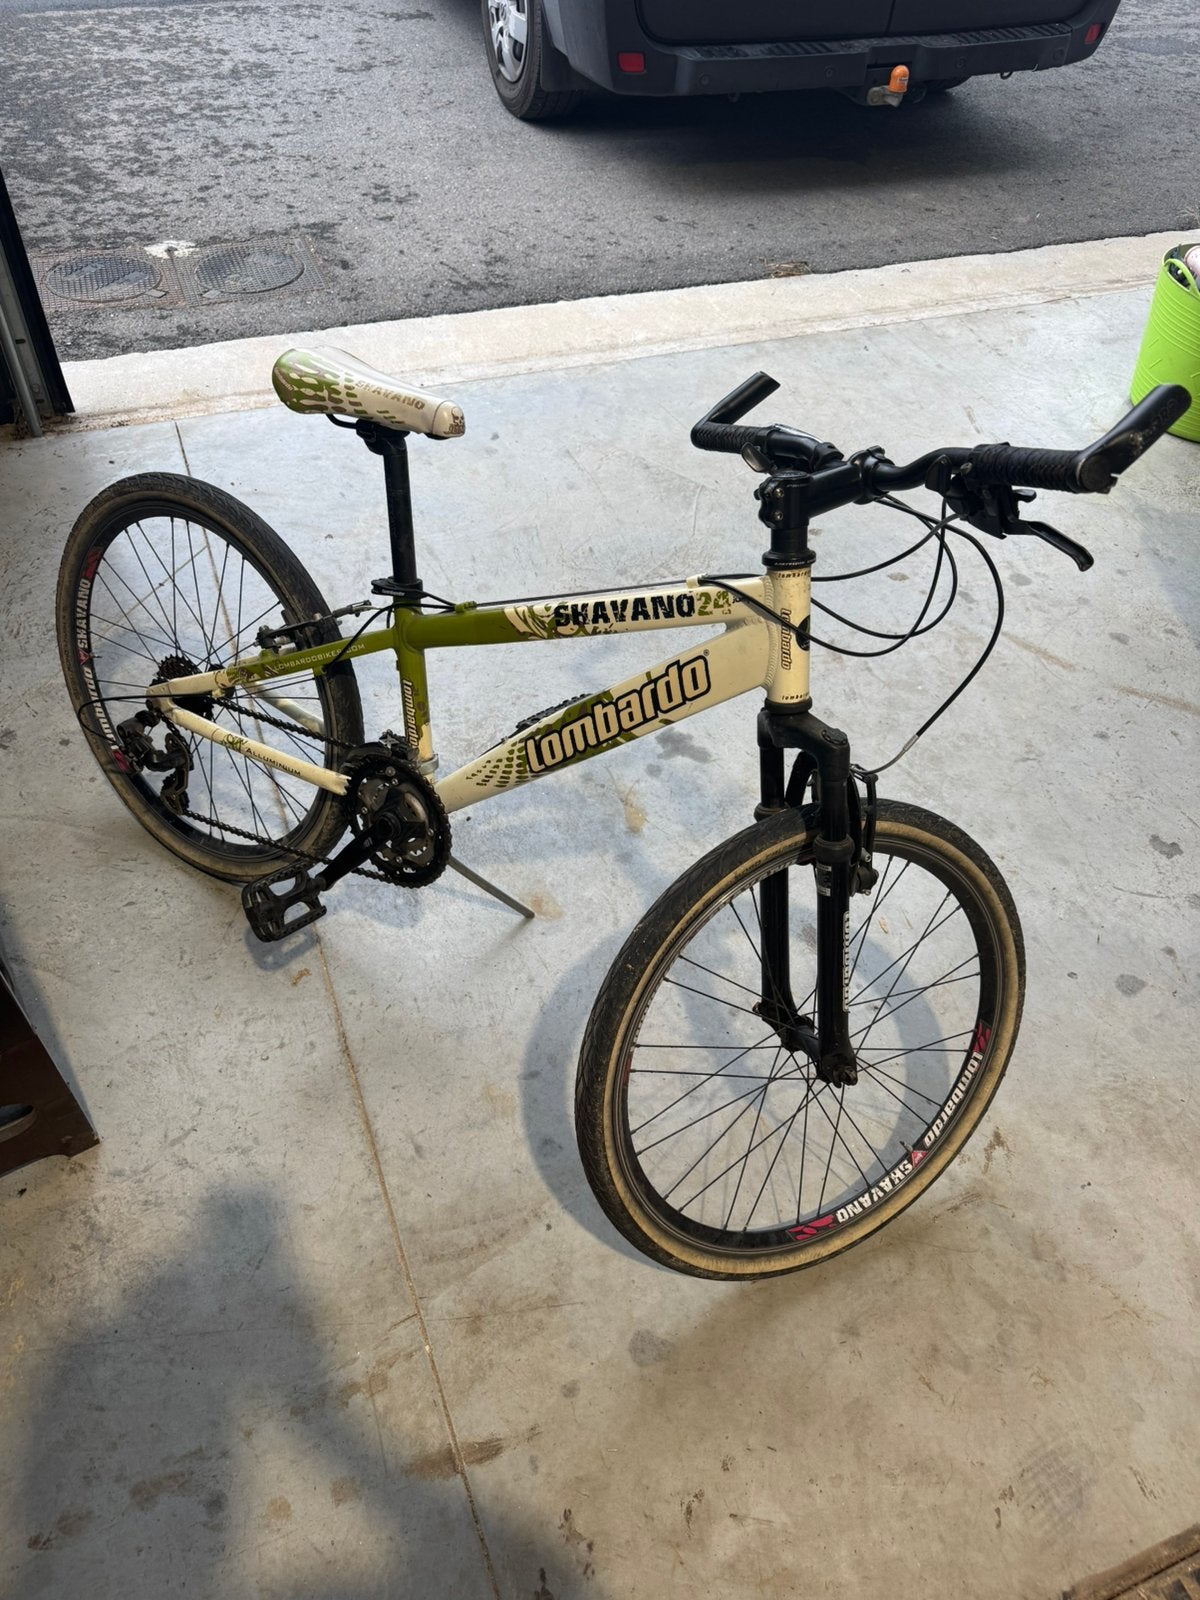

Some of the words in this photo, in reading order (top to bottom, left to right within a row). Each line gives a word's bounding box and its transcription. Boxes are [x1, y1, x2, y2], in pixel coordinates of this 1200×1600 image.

[355, 379, 426, 410] SHAVANO
[554, 593, 696, 627] SHAVANO
[525, 655, 711, 773] lombardo
[924, 1051, 984, 1148] lombardo
